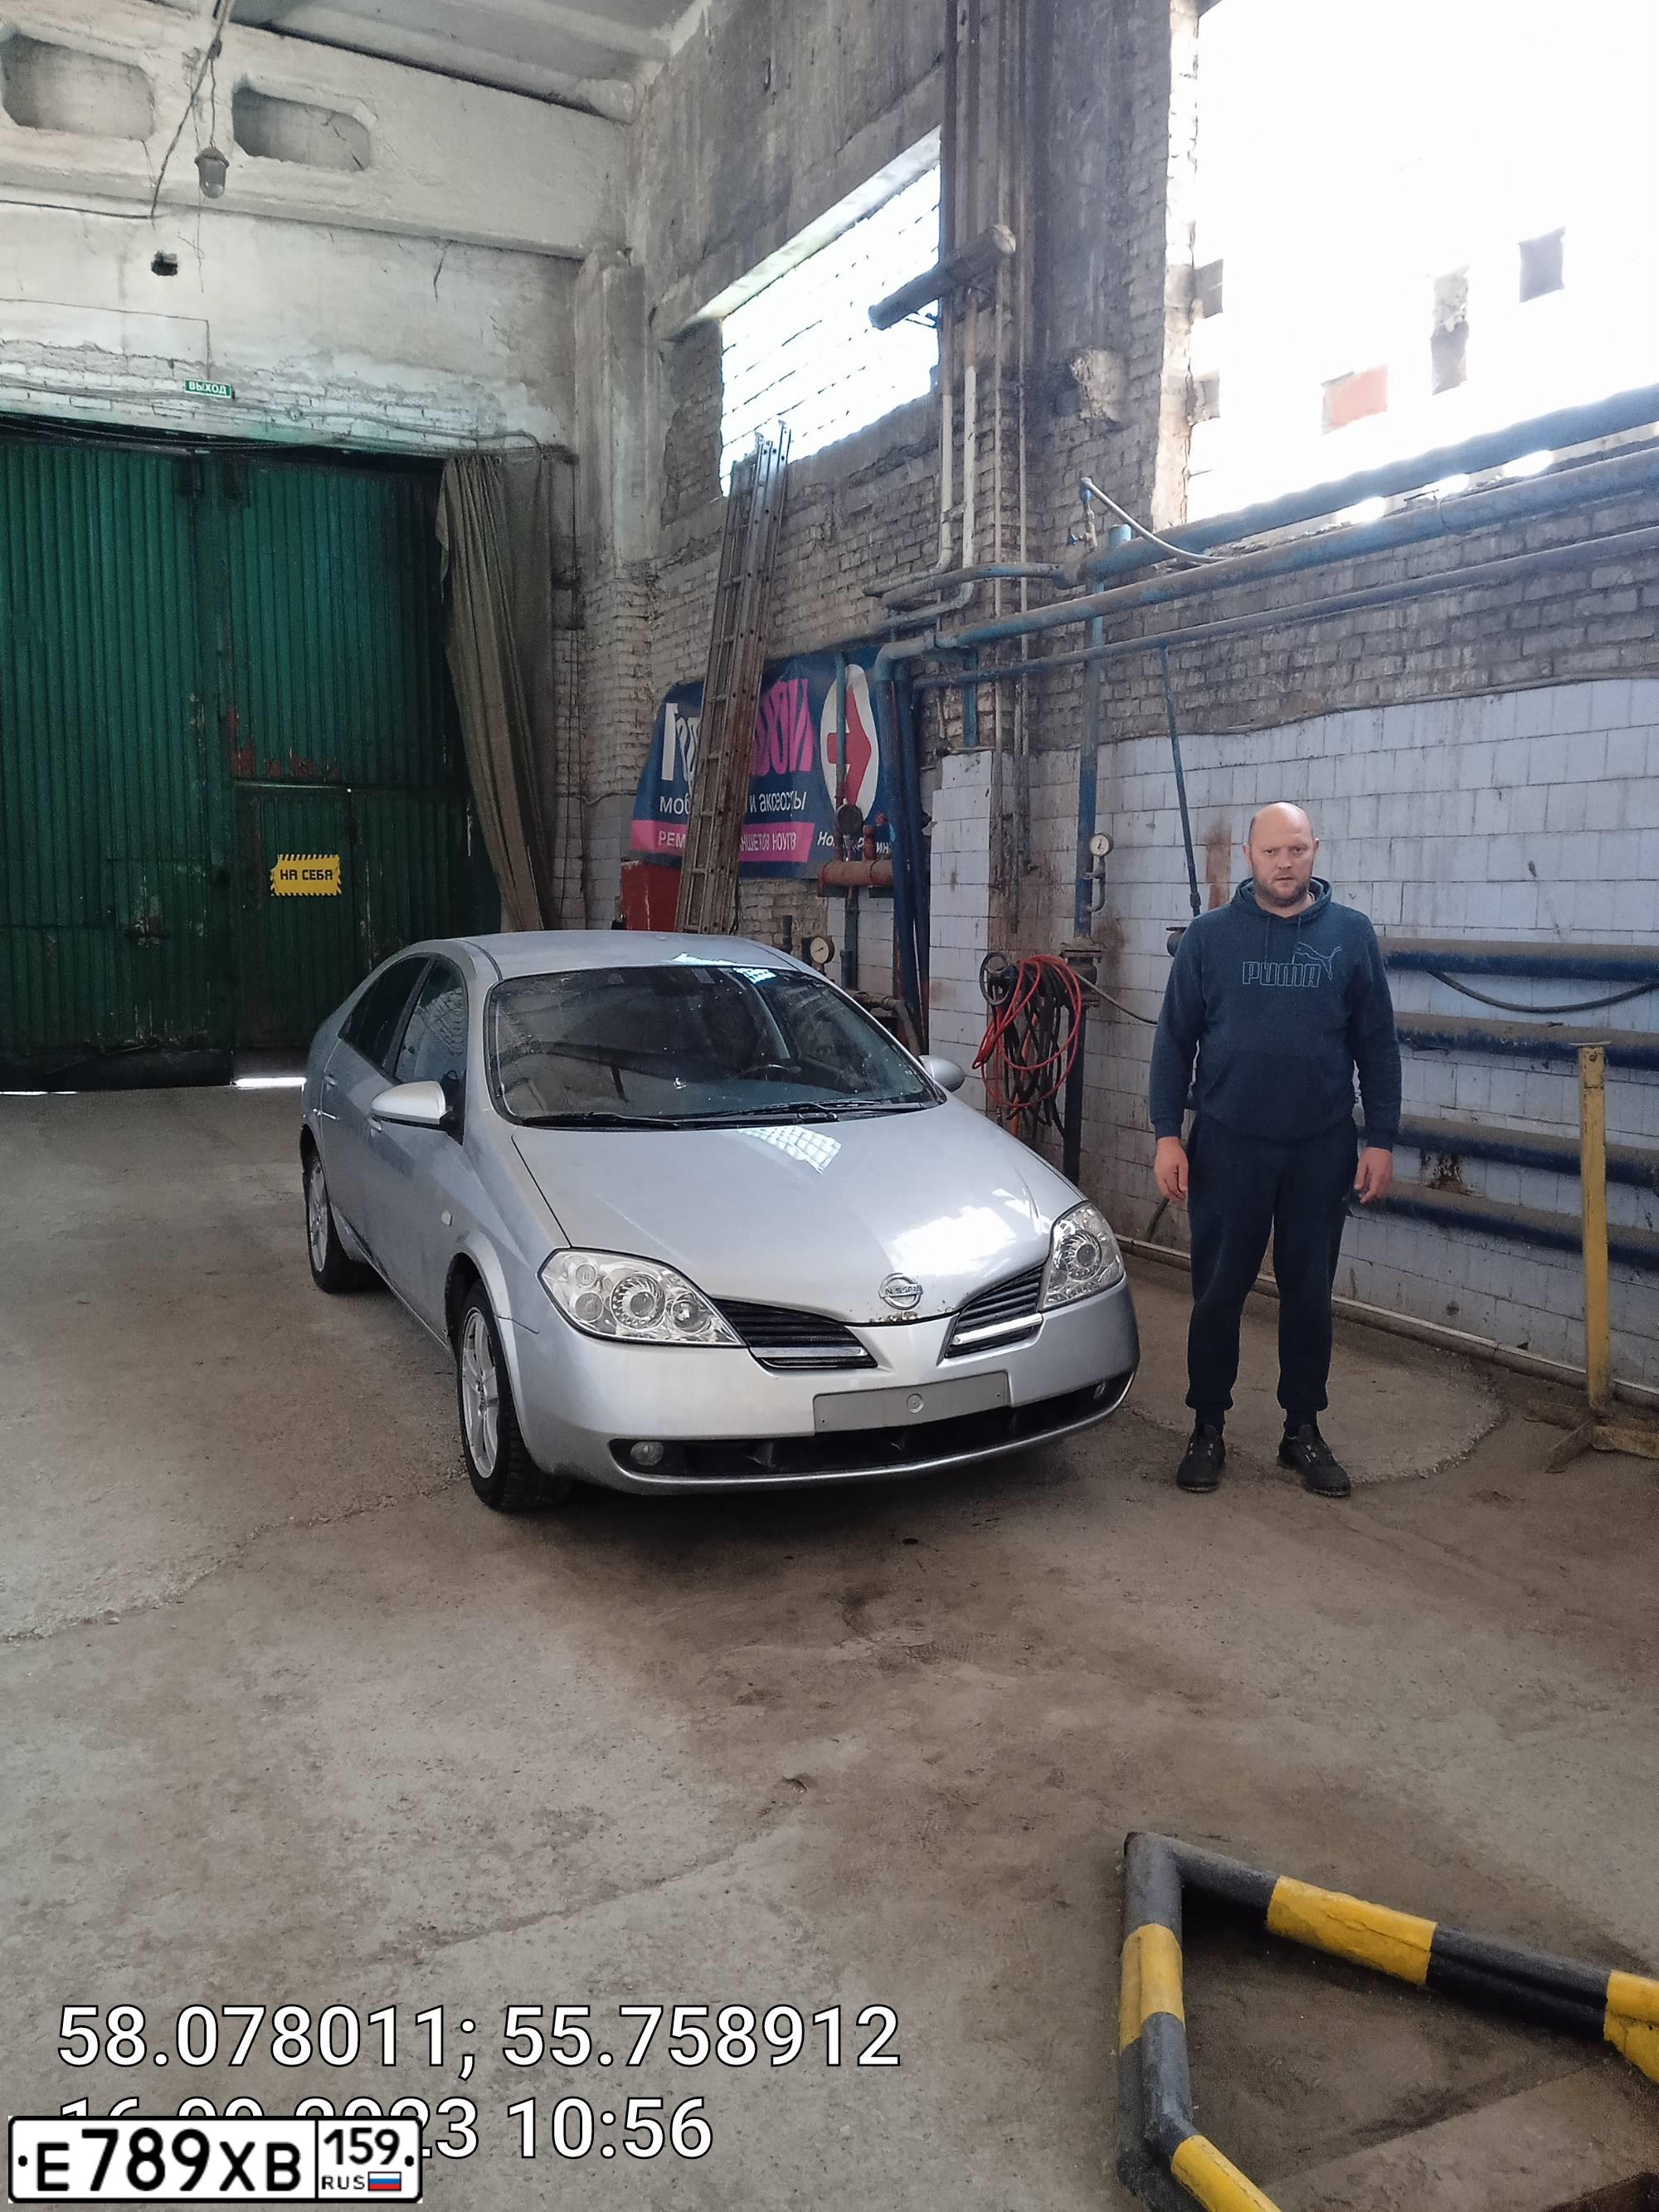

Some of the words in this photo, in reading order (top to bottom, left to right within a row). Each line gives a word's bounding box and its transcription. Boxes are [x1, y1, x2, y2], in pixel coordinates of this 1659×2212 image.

[188, 381, 227, 395] ВЫХОД
[280, 869, 298, 880] НА
[302, 869, 333, 880] СЕБЯ
[1243, 961, 1321, 987] PUMA
